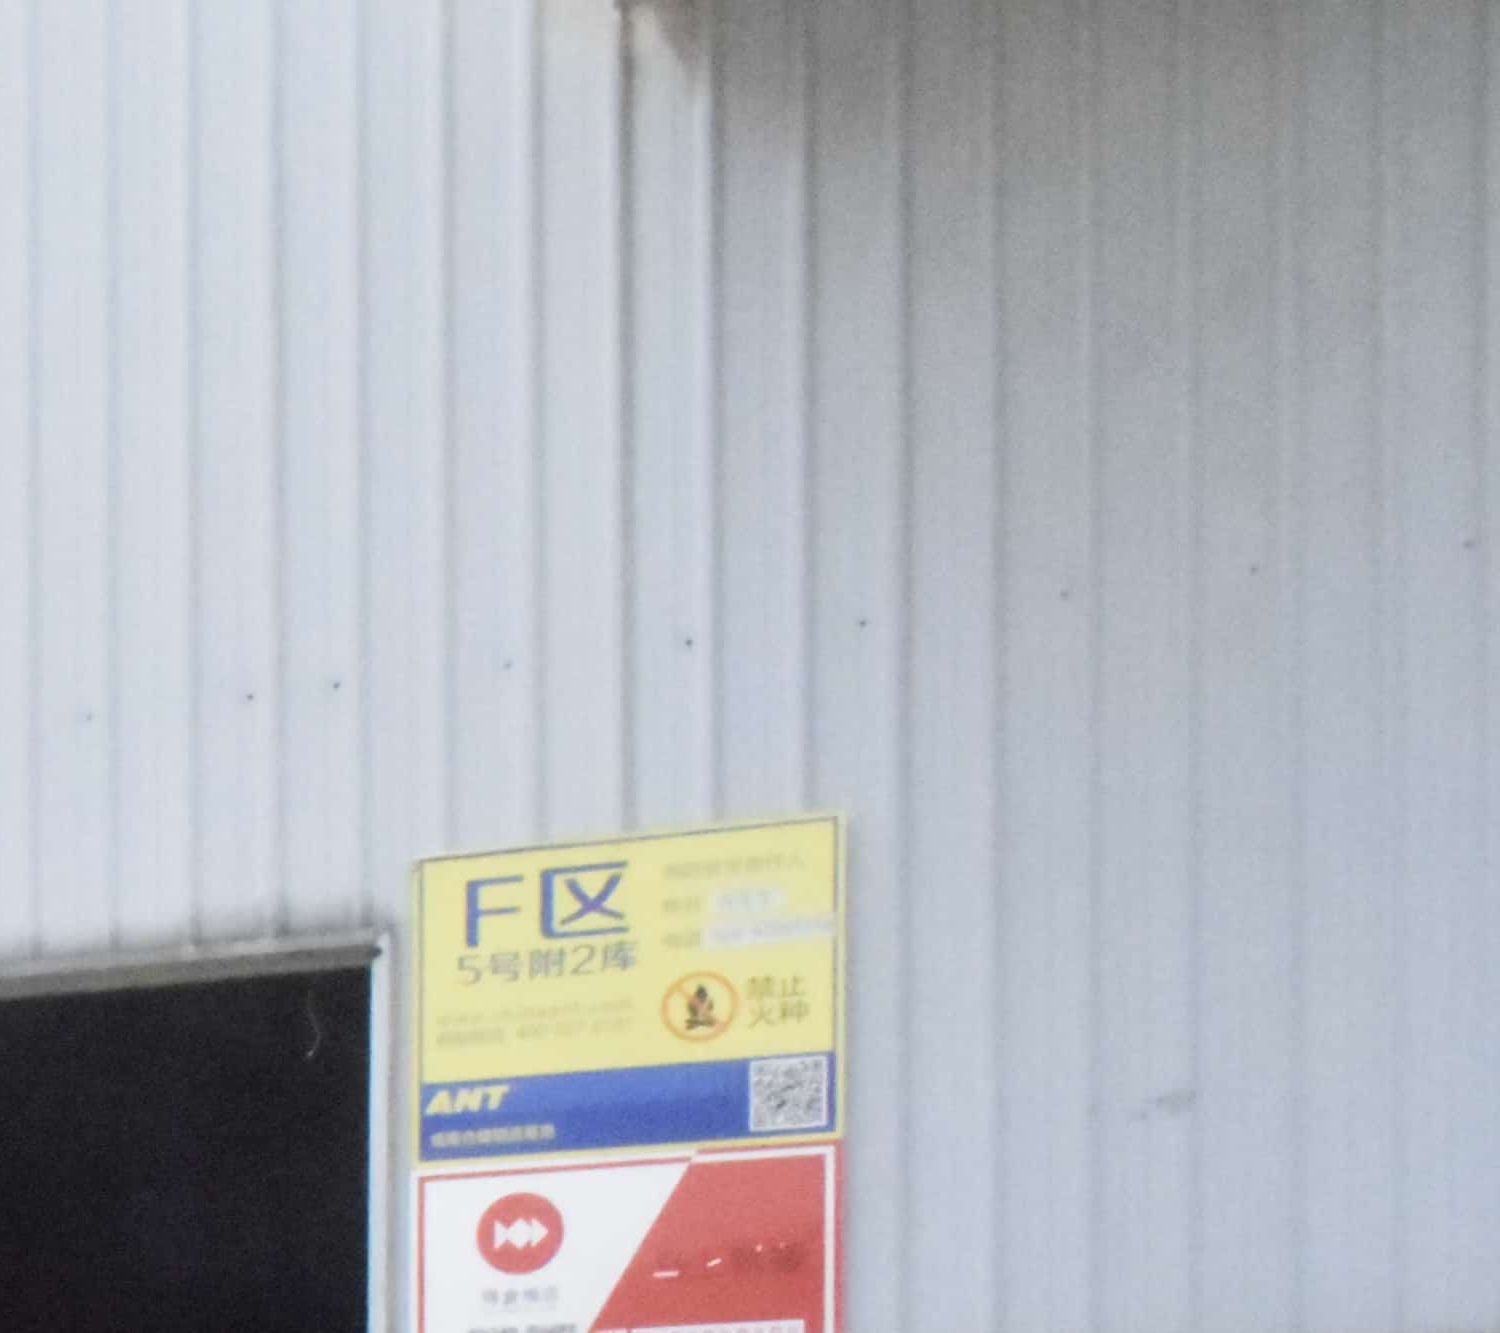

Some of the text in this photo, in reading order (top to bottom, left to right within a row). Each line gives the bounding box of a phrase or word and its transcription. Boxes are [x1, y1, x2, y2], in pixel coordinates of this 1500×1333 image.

[456, 941, 639, 985] 5号附2库
[425, 1084, 510, 1116] ANT
